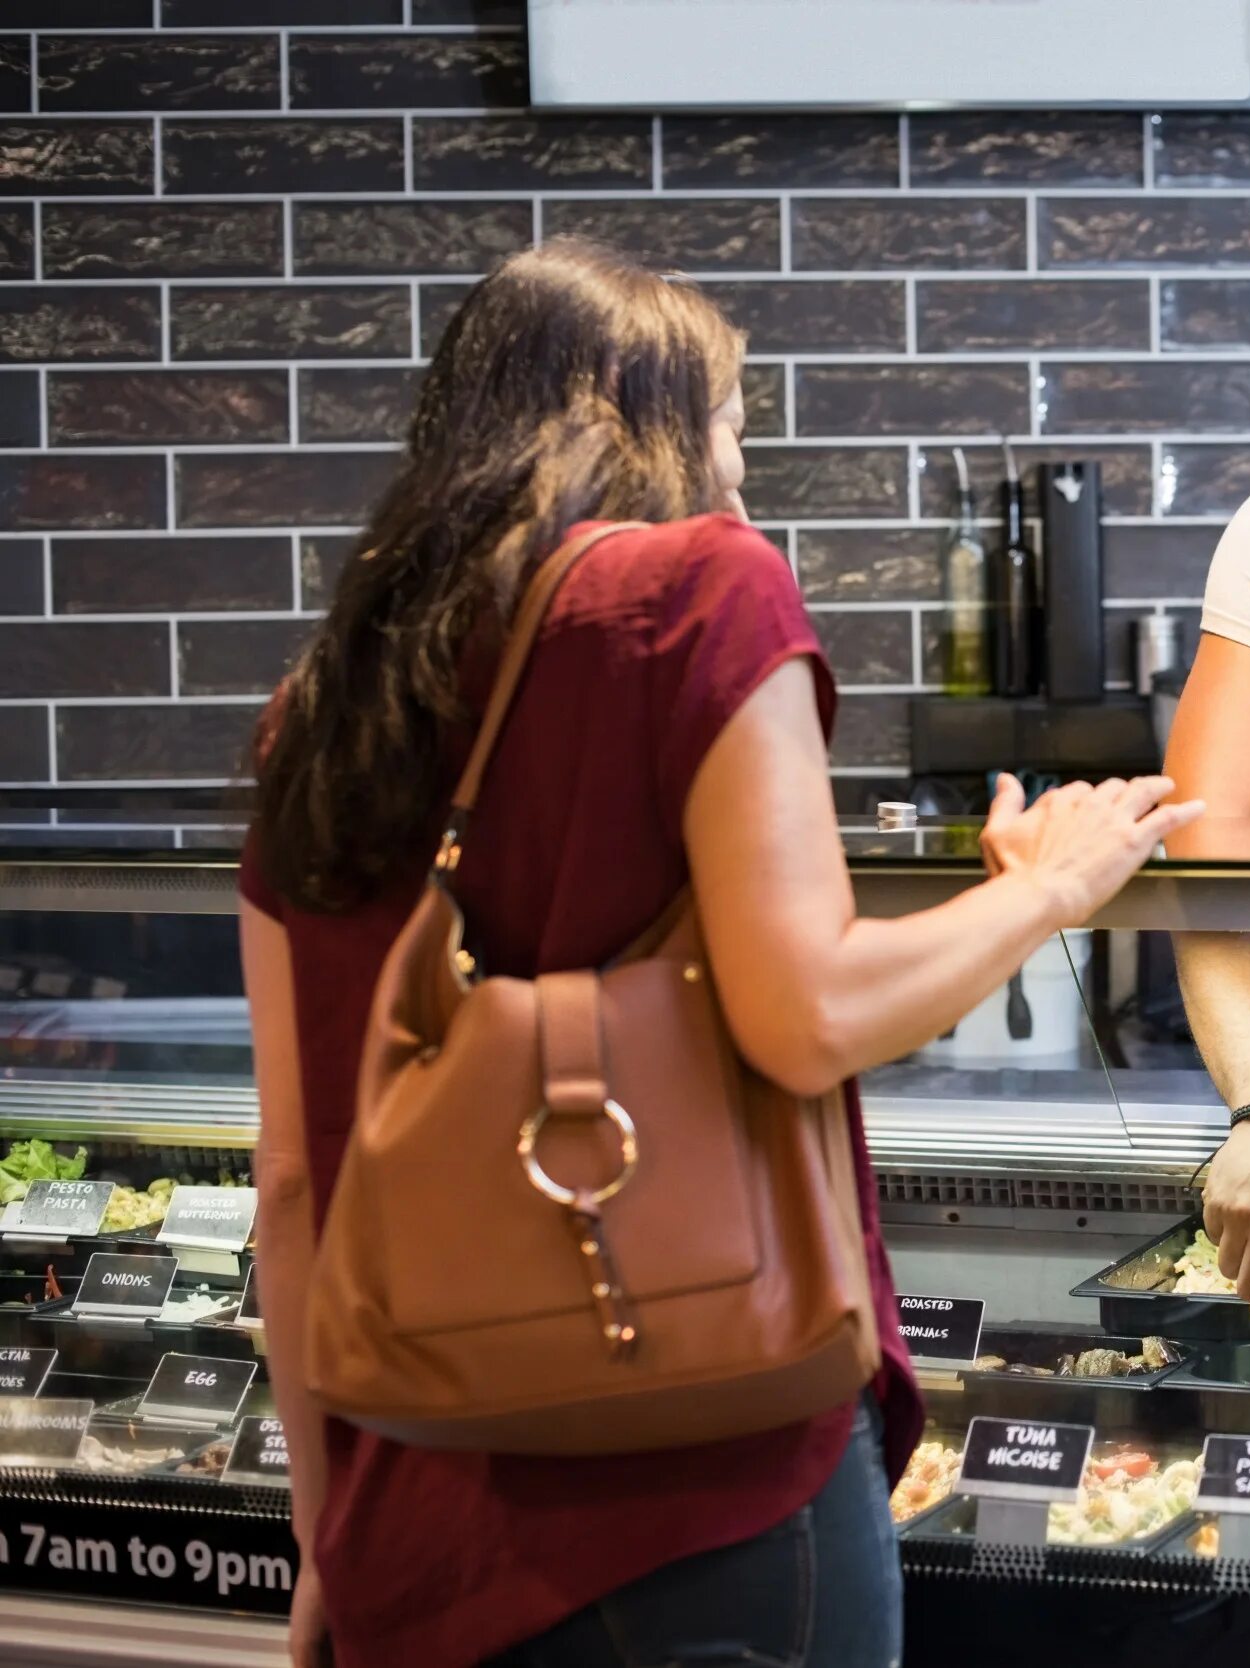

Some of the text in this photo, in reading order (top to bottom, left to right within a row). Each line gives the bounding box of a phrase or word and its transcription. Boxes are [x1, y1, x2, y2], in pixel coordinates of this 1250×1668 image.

[48, 1181, 94, 1195] PESTO
[42, 1197, 88, 1210] PASTA
[177, 1209, 242, 1221] BUTTERNUT
[101, 1272, 153, 1287] ONIONS
[900, 1297, 954, 1312] ROASTED
[184, 1370, 218, 1387] EGG
[1005, 1425, 1057, 1447] TUNA
[986, 1447, 1064, 1471] NICOISE
[20, 1521, 118, 1574] 7am
[127, 1535, 177, 1579] to
[184, 1539, 293, 1596] 9pm
